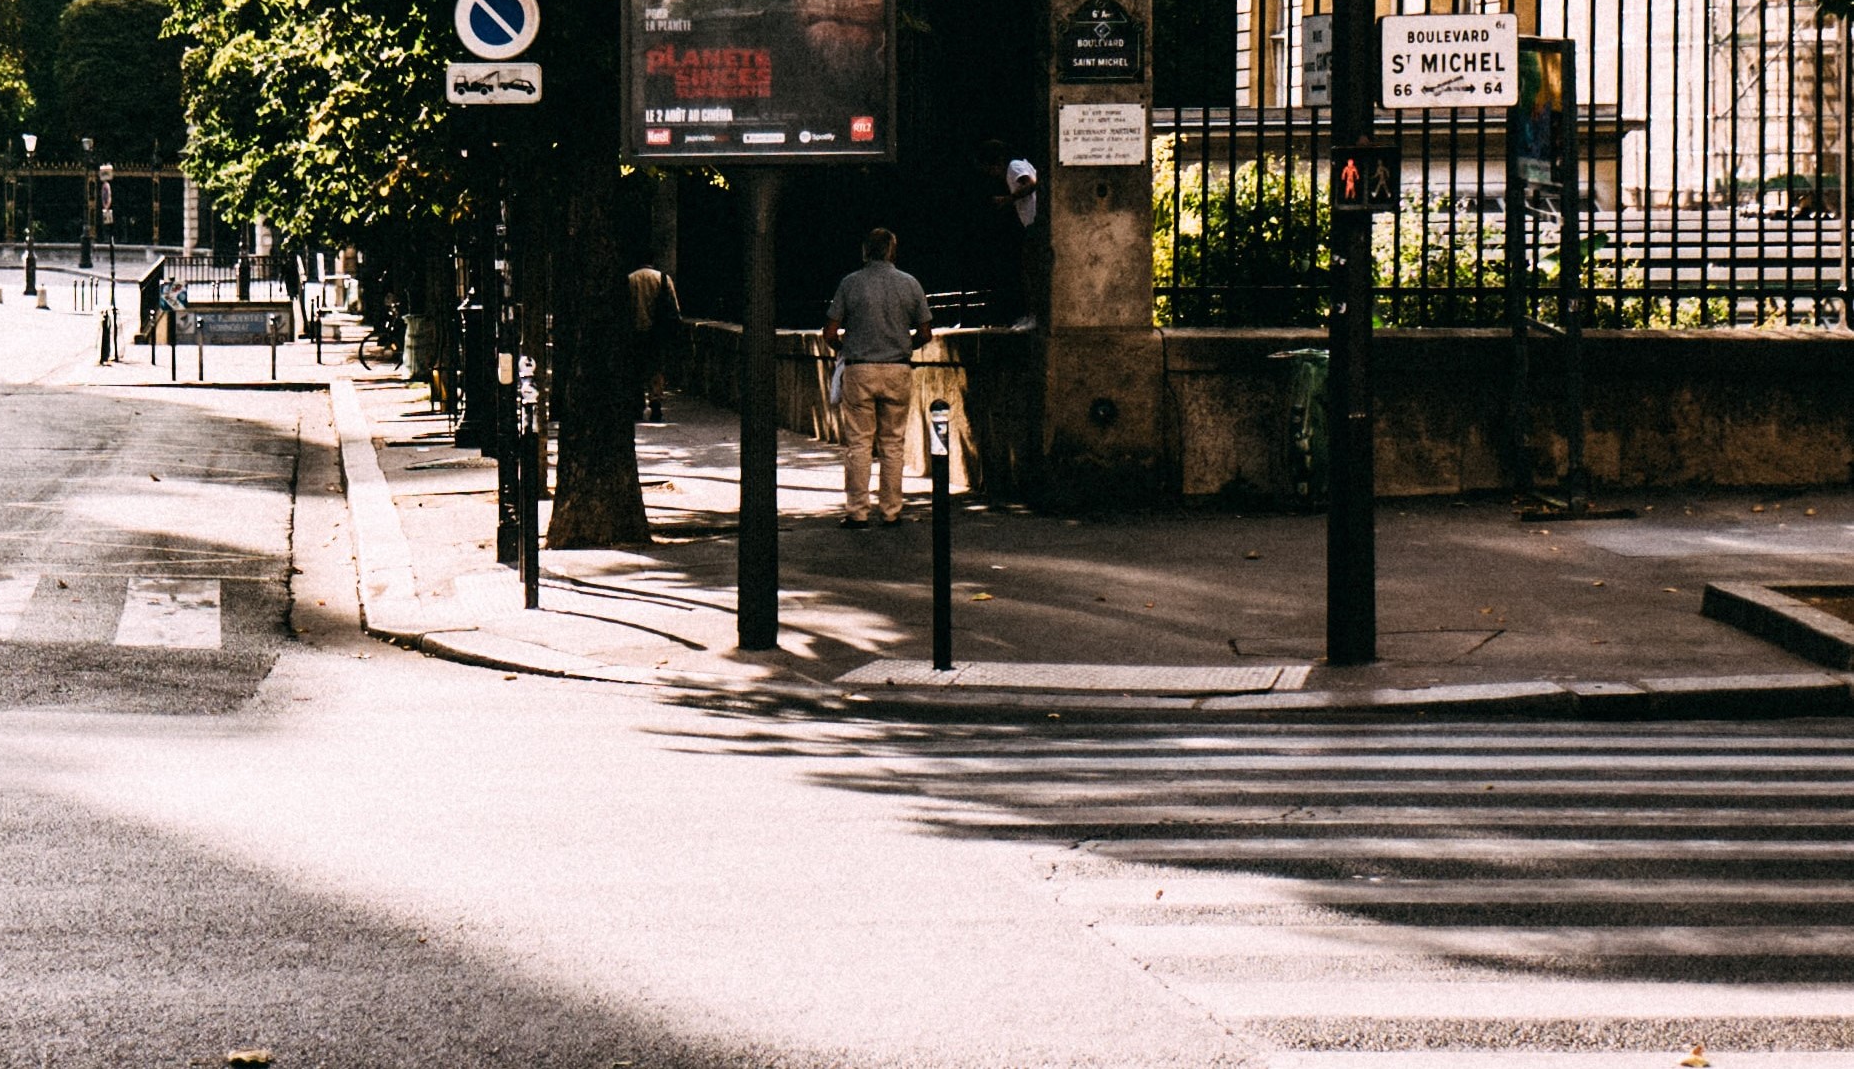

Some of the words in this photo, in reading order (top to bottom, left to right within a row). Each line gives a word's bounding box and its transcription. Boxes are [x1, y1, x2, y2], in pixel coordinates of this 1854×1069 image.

[1077, 39, 1124, 47] BOULEVARD
[1407, 30, 1489, 44] BOULEVARD
[1073, 58, 1095, 66] SAINT
[1098, 58, 1128, 66] MICHEL
[1422, 53, 1505, 73] MICHEL
[1394, 83, 1413, 97] 66
[1483, 82, 1503, 95] 64
[646, 109, 654, 122] LE
[656, 109, 663, 122] 2
[688, 109, 700, 122] AU
